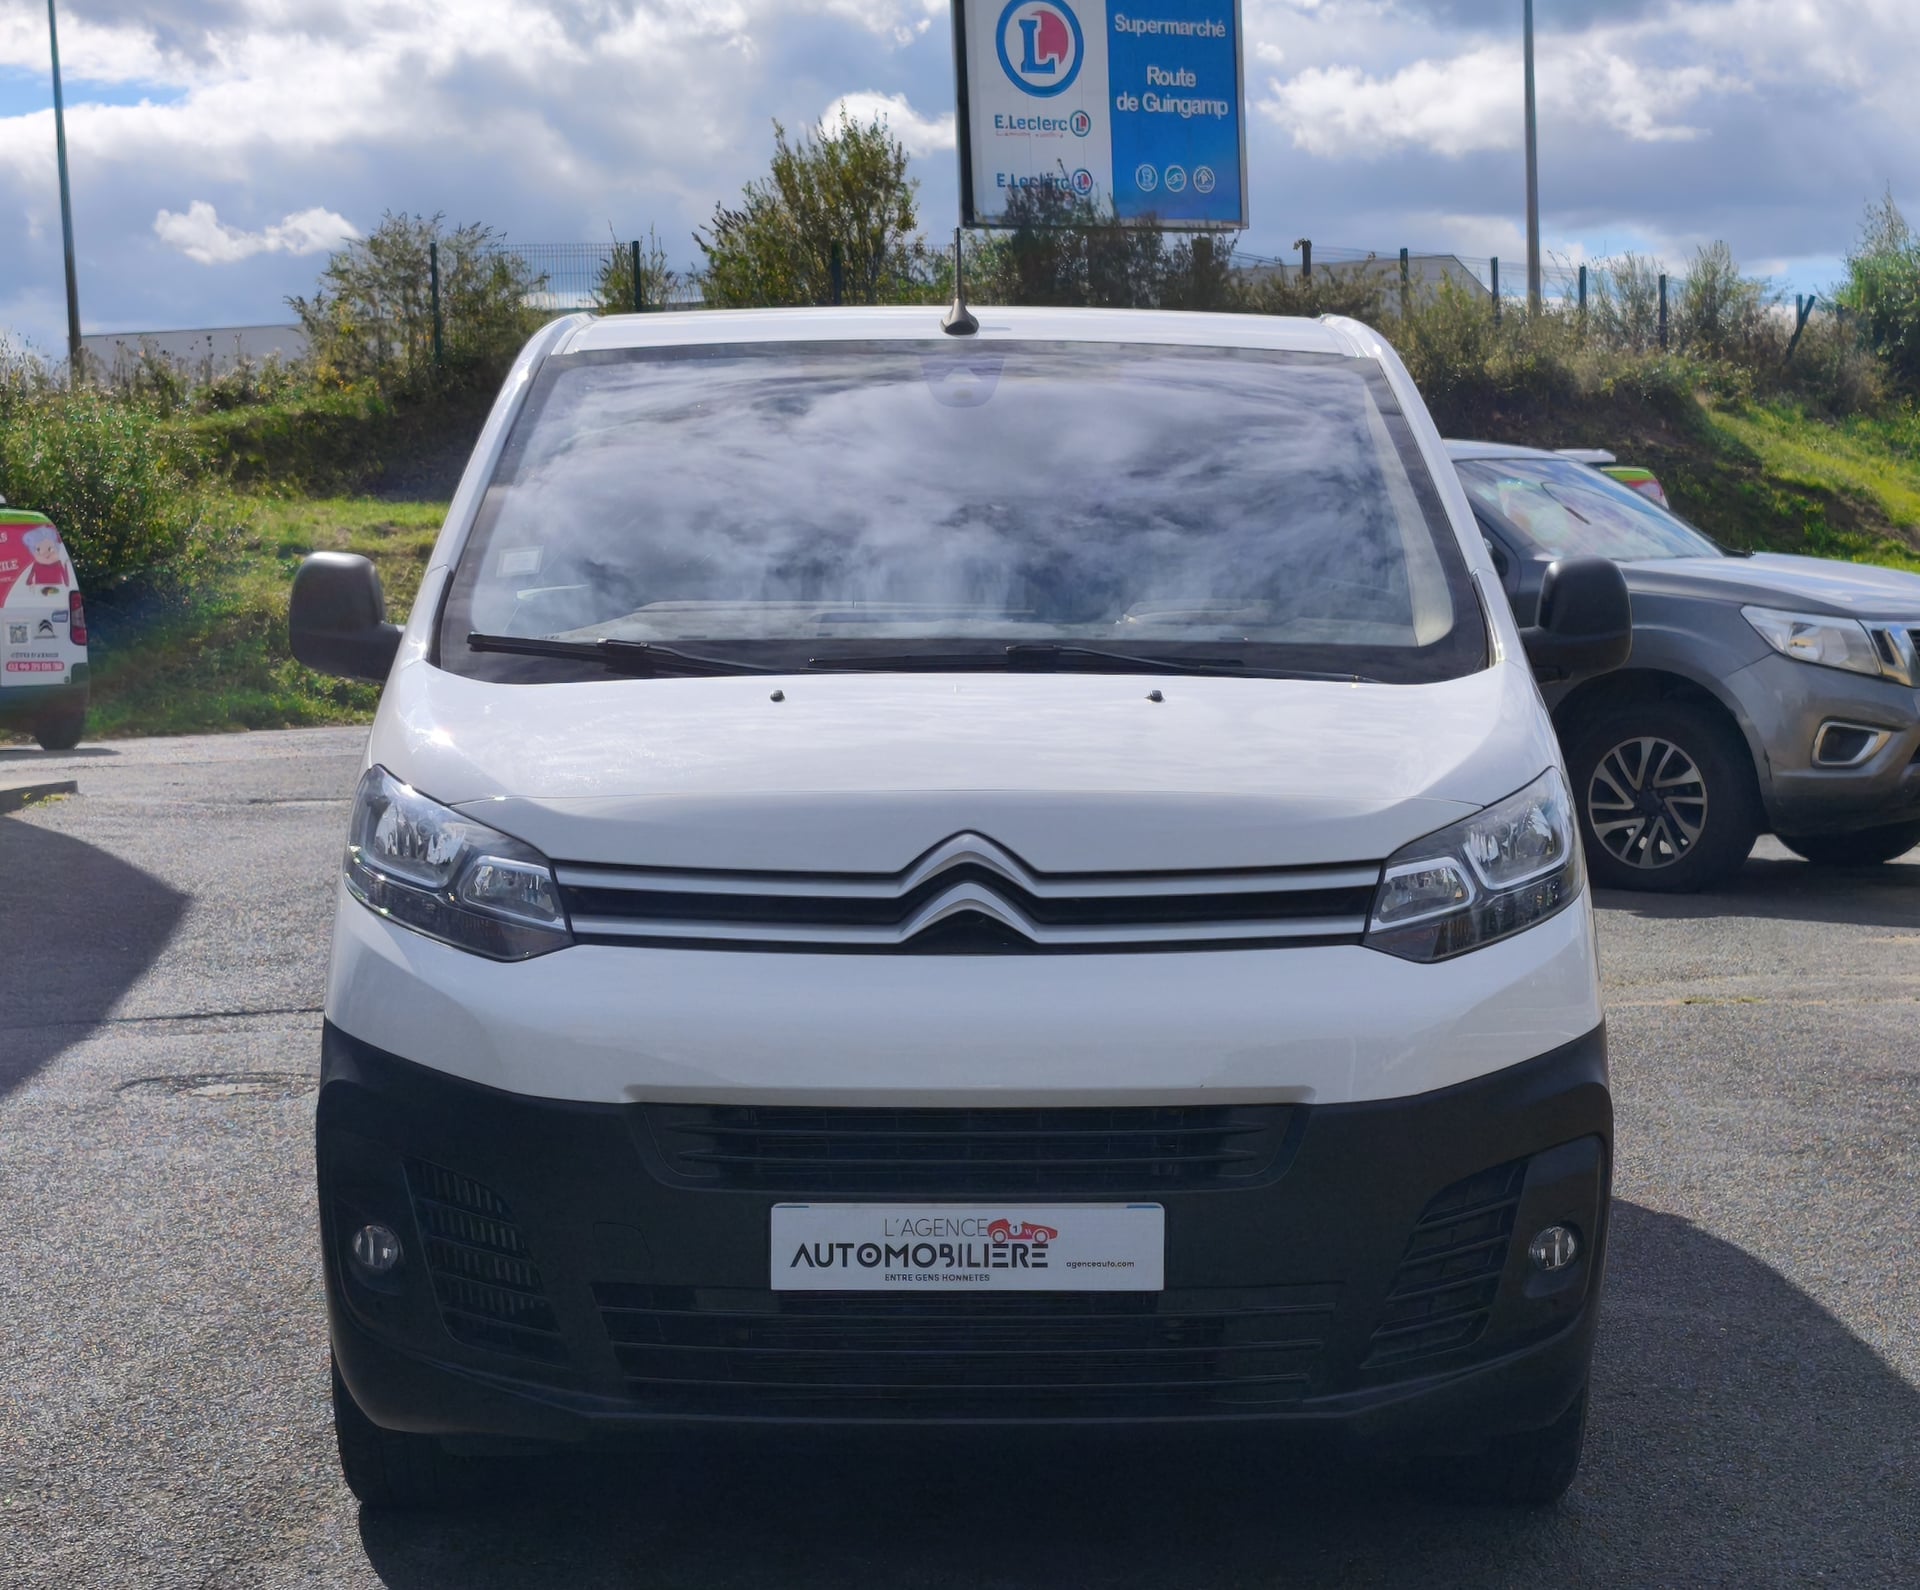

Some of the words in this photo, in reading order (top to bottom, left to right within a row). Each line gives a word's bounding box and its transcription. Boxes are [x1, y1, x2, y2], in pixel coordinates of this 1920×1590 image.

[1114, 14, 1226, 37] Supermarché
[1146, 65, 1197, 87] Route
[1116, 91, 1139, 112] de
[1142, 92, 1229, 120] Guingamp
[994, 114, 1068, 132] E.Leclerc
[884, 1218, 988, 1237] L'AGENCE
[1066, 1260, 1135, 1270] agenceauto.com
[885, 1273, 913, 1282] ENTRE
[915, 1273, 940, 1282] GENS
